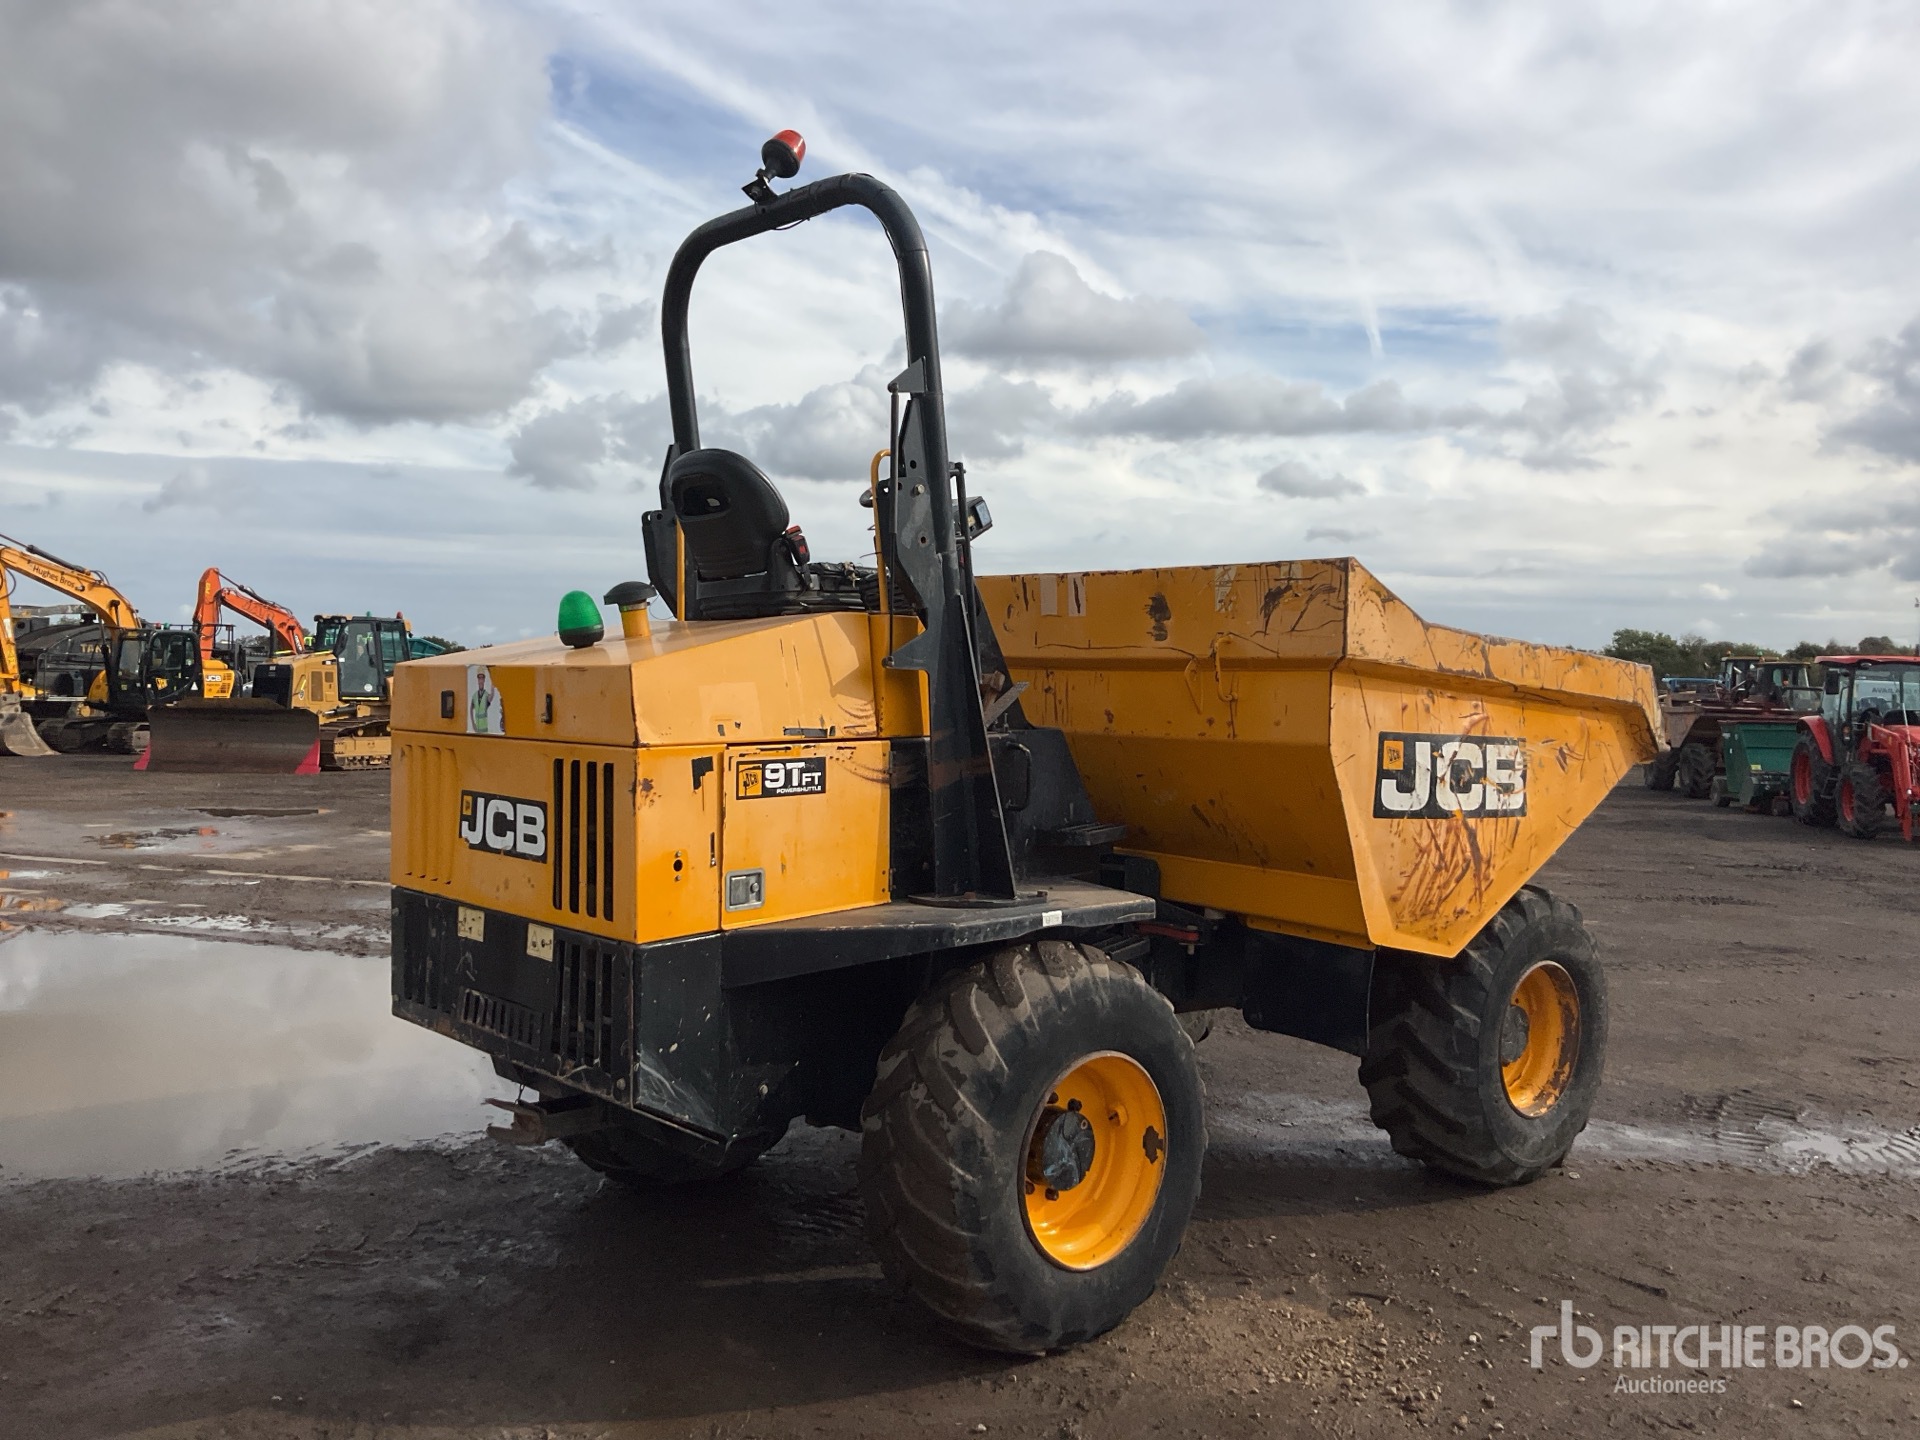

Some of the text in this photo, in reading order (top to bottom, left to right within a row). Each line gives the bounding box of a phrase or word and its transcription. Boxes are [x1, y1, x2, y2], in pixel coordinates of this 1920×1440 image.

[32, 565, 75, 589] Hughes Bros
[80, 643, 111, 653] TAN
[1380, 741, 1524, 811] JCB
[776, 785, 822, 794] POWERSHUTTLE
[461, 797, 546, 857] JCB
